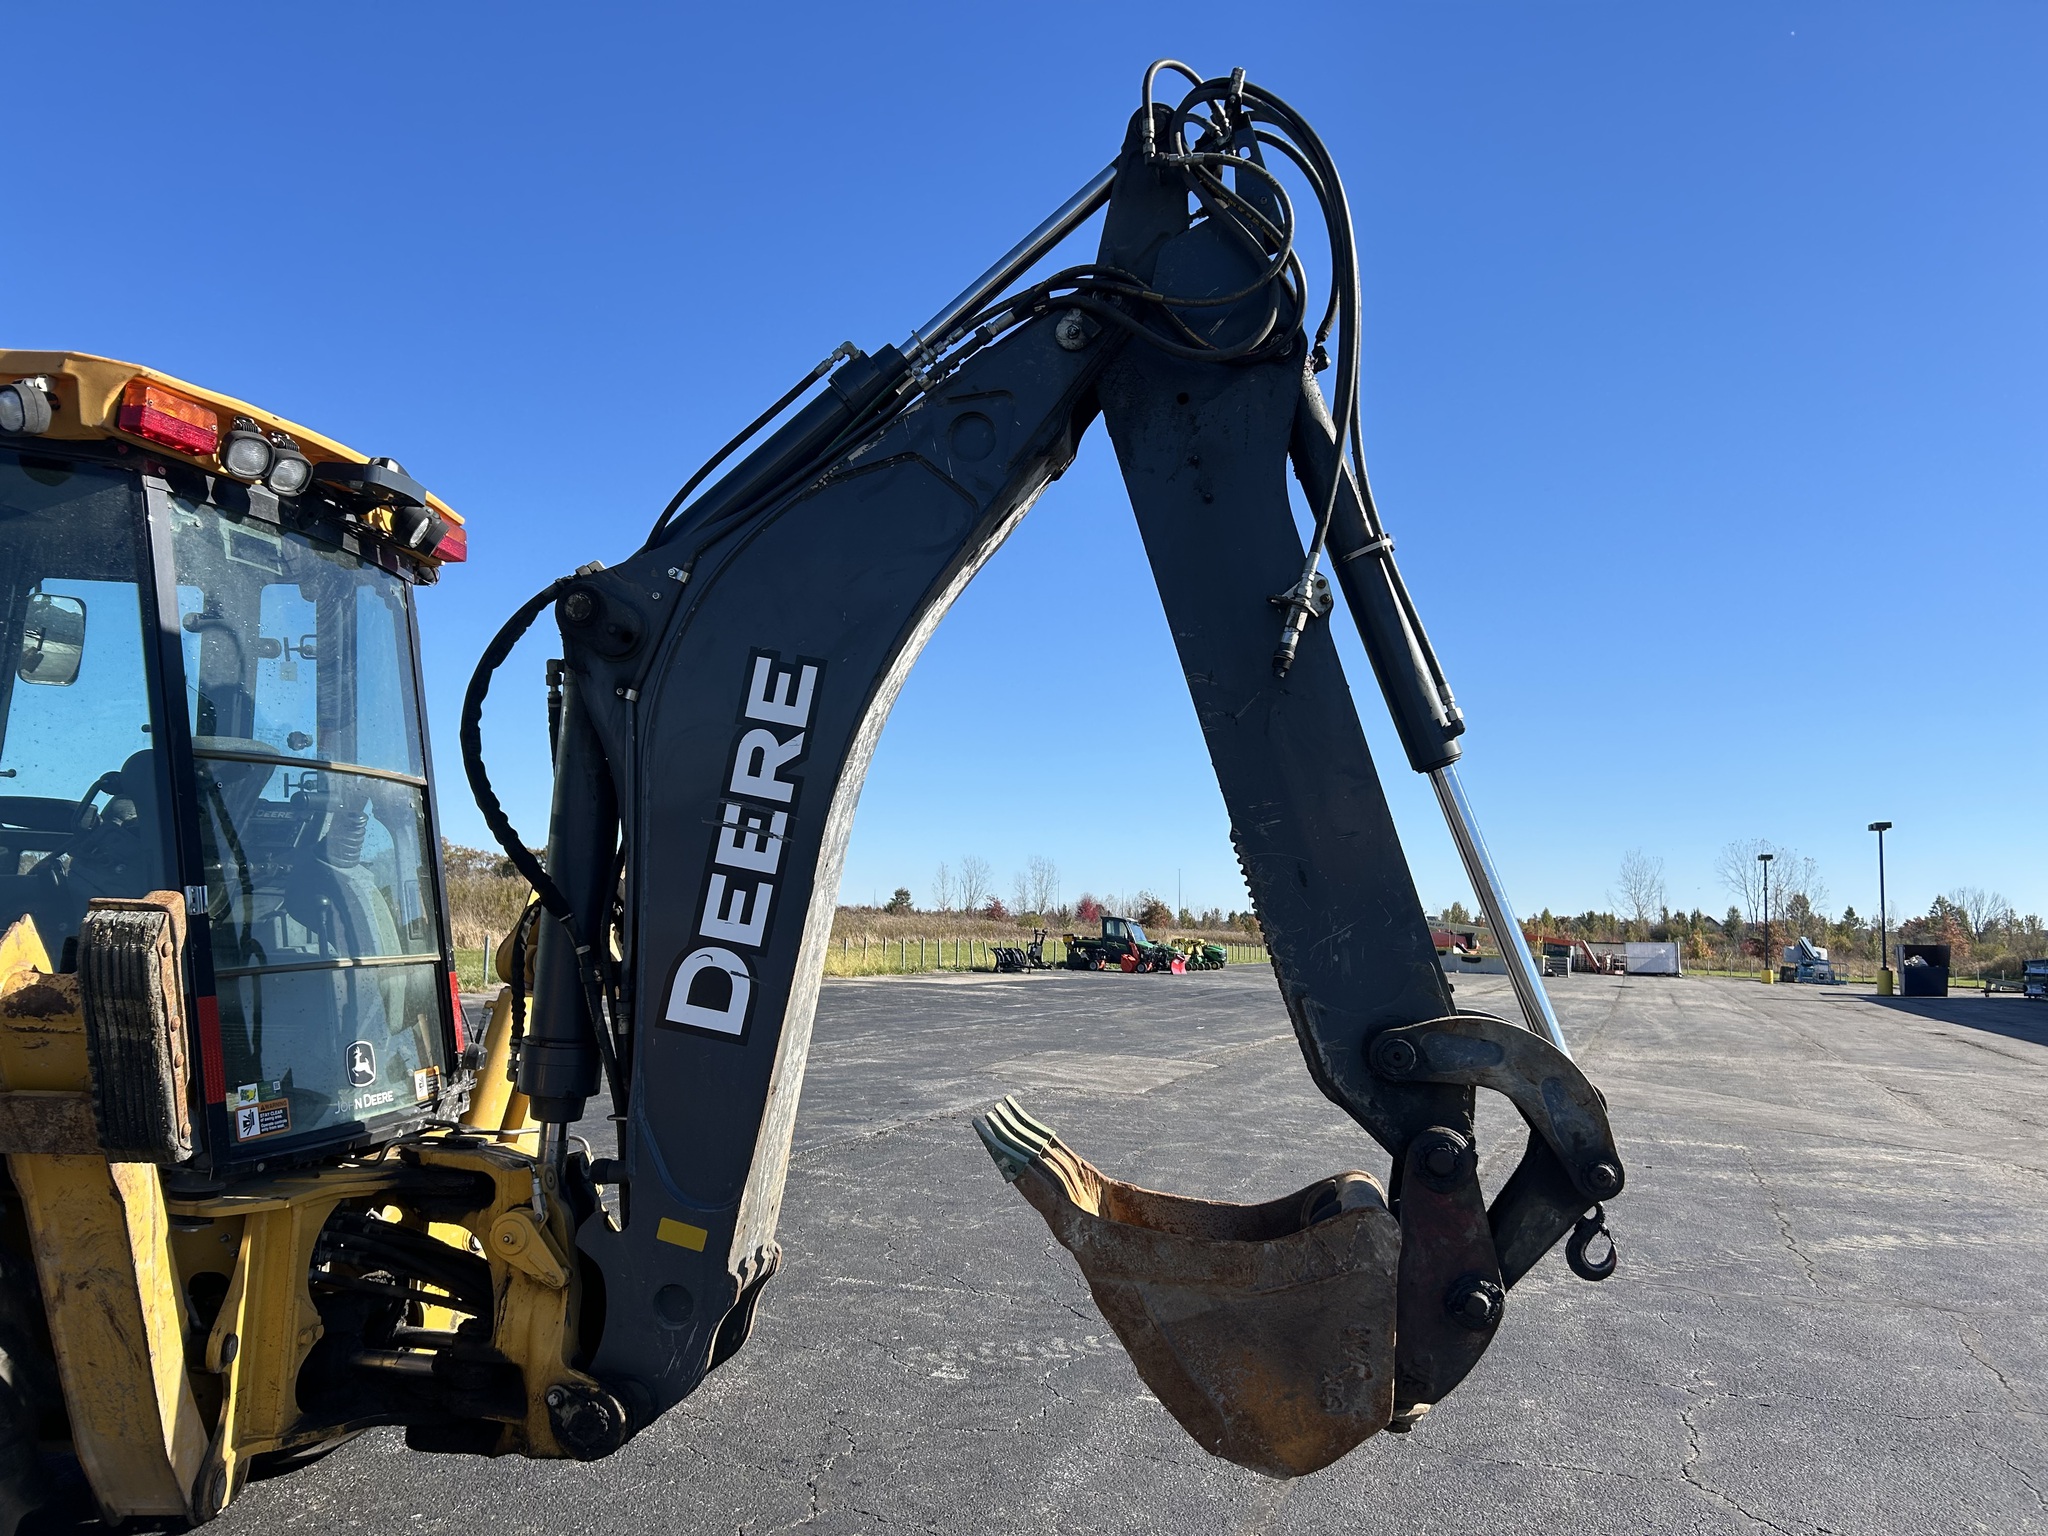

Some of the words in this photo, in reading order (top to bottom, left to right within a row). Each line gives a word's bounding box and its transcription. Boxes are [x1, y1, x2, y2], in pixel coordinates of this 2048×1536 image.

[665, 656, 819, 1036] DEERE
[266, 1100, 287, 1110] WARNING
[363, 1090, 394, 1108] DEERE
